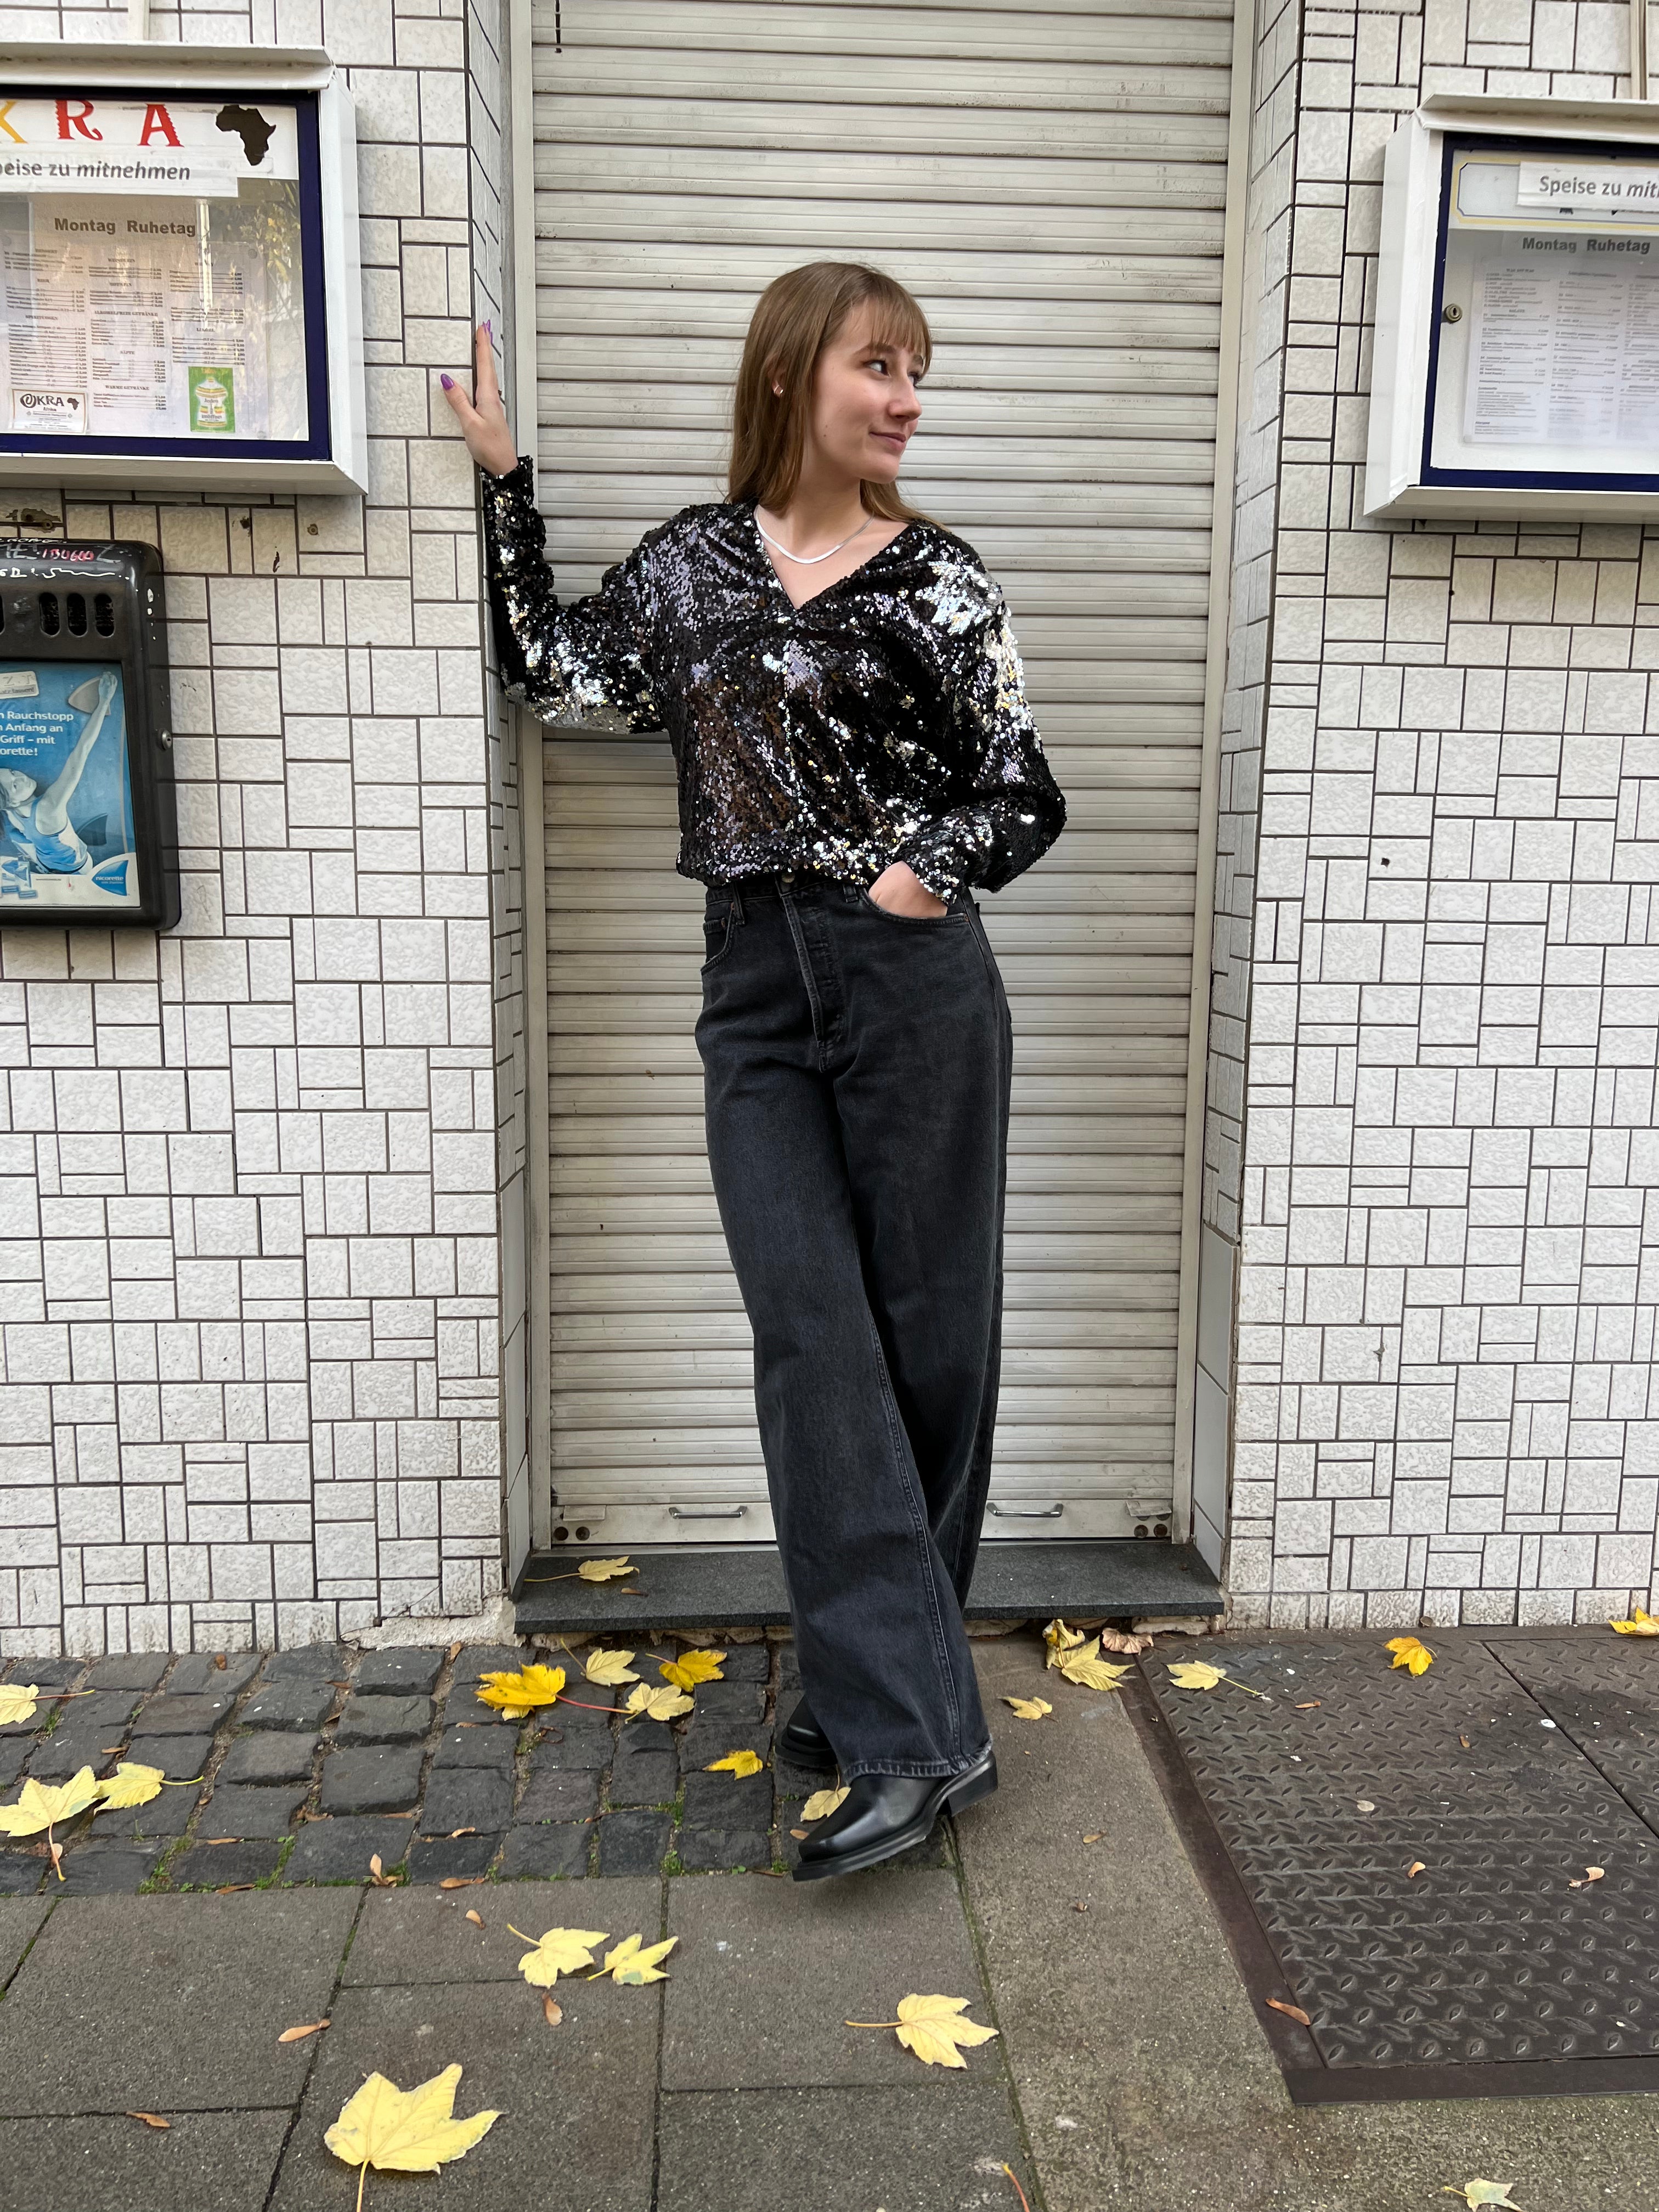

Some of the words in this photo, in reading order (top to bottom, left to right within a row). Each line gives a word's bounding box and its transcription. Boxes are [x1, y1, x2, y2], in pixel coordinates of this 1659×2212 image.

[0, 159, 42, 177] eise
[49, 163, 70, 177] zu
[77, 160, 190, 180] mitnehmen
[1539, 176, 1596, 196] Speise
[1602, 183, 1622, 196] zu
[55, 218, 116, 235] Montag
[127, 220, 196, 237] Ruhetag
[1522, 237, 1577, 253] Montag
[1587, 239, 1651, 254] Ruhetag
[20, 393, 64, 408] OKRA
[7, 711, 74, 721] Rauchstopp
[5, 723, 47, 733] Anfang
[0, 735, 25, 743] Griff
[36, 735, 56, 744] mit
